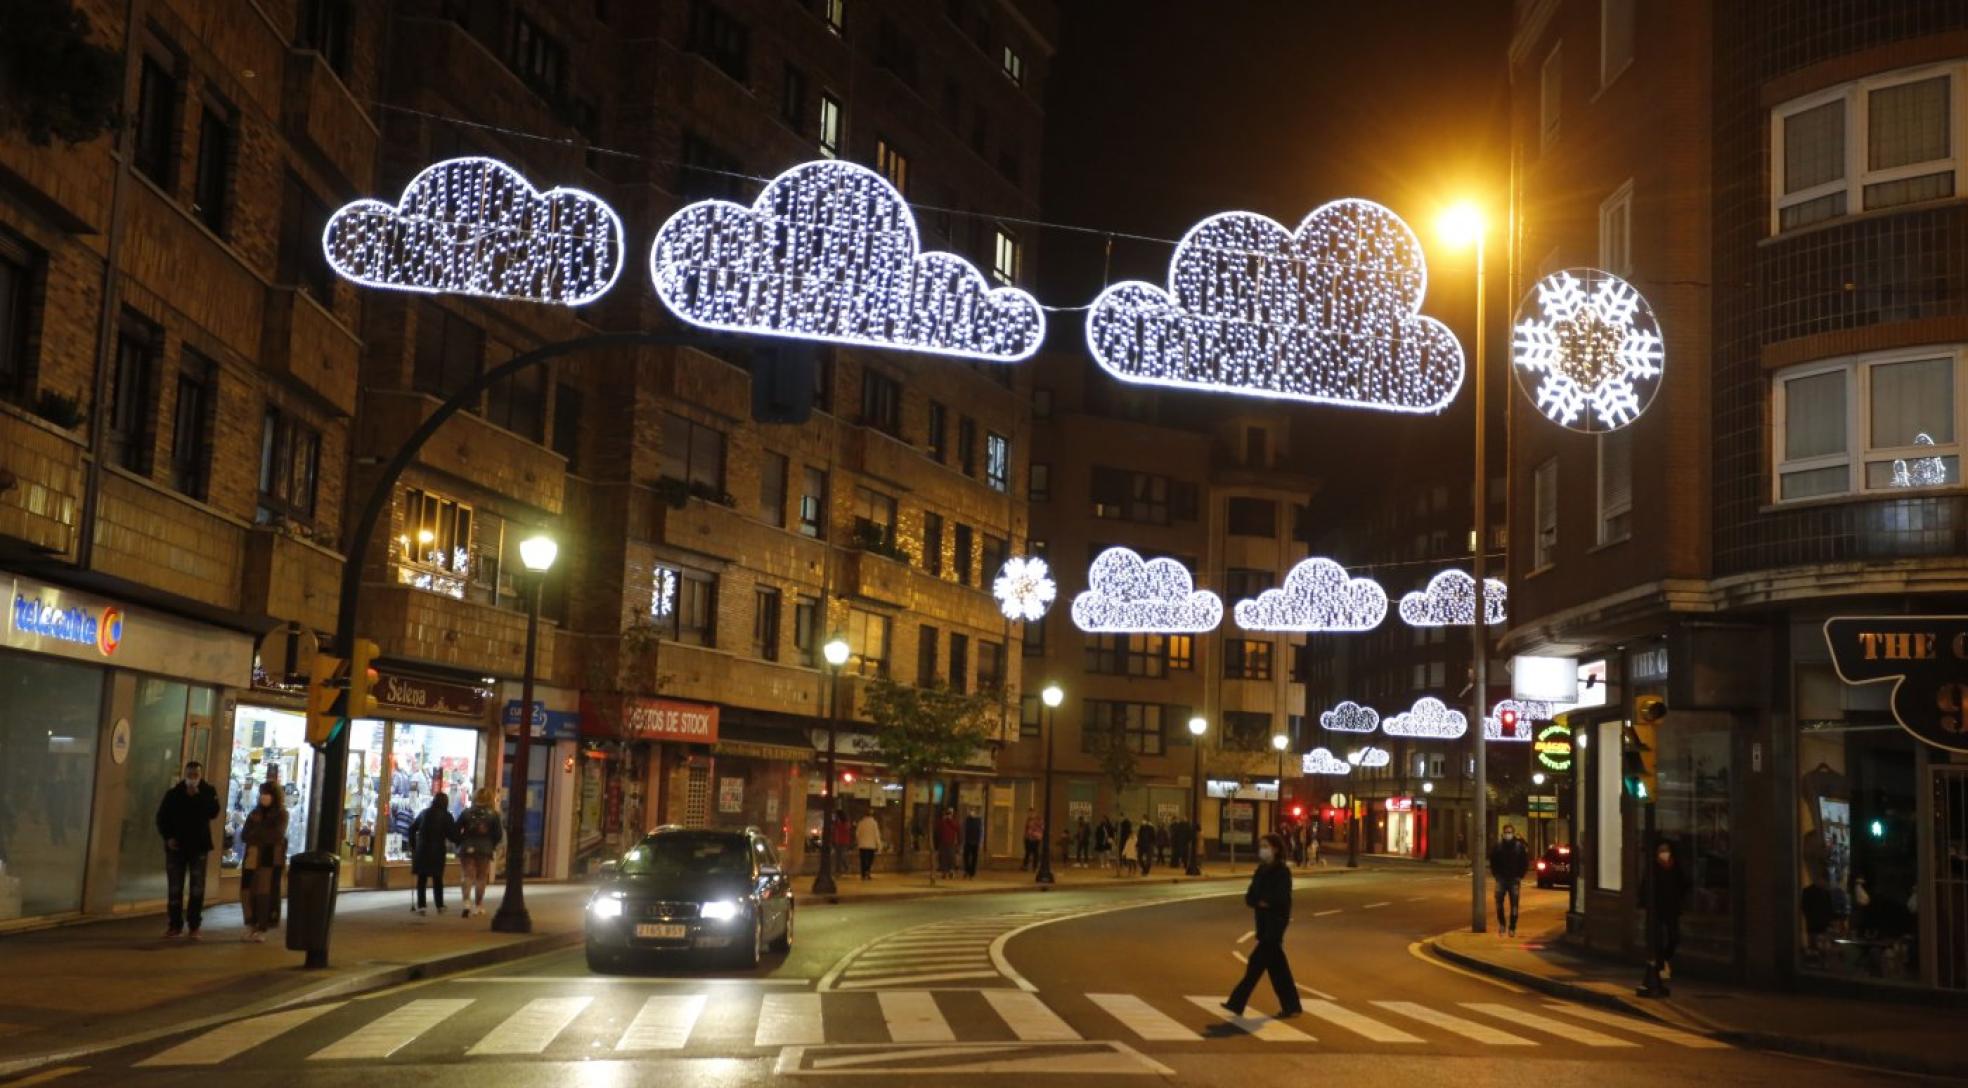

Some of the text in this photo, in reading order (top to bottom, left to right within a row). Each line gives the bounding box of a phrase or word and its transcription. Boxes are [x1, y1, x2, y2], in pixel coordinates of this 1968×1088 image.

[15, 594, 97, 645] telecable
[1859, 632, 1936, 660] THE
[386, 675, 427, 706] Selena
[666, 711, 679, 733] DE
[681, 712, 709, 736] STOCK
